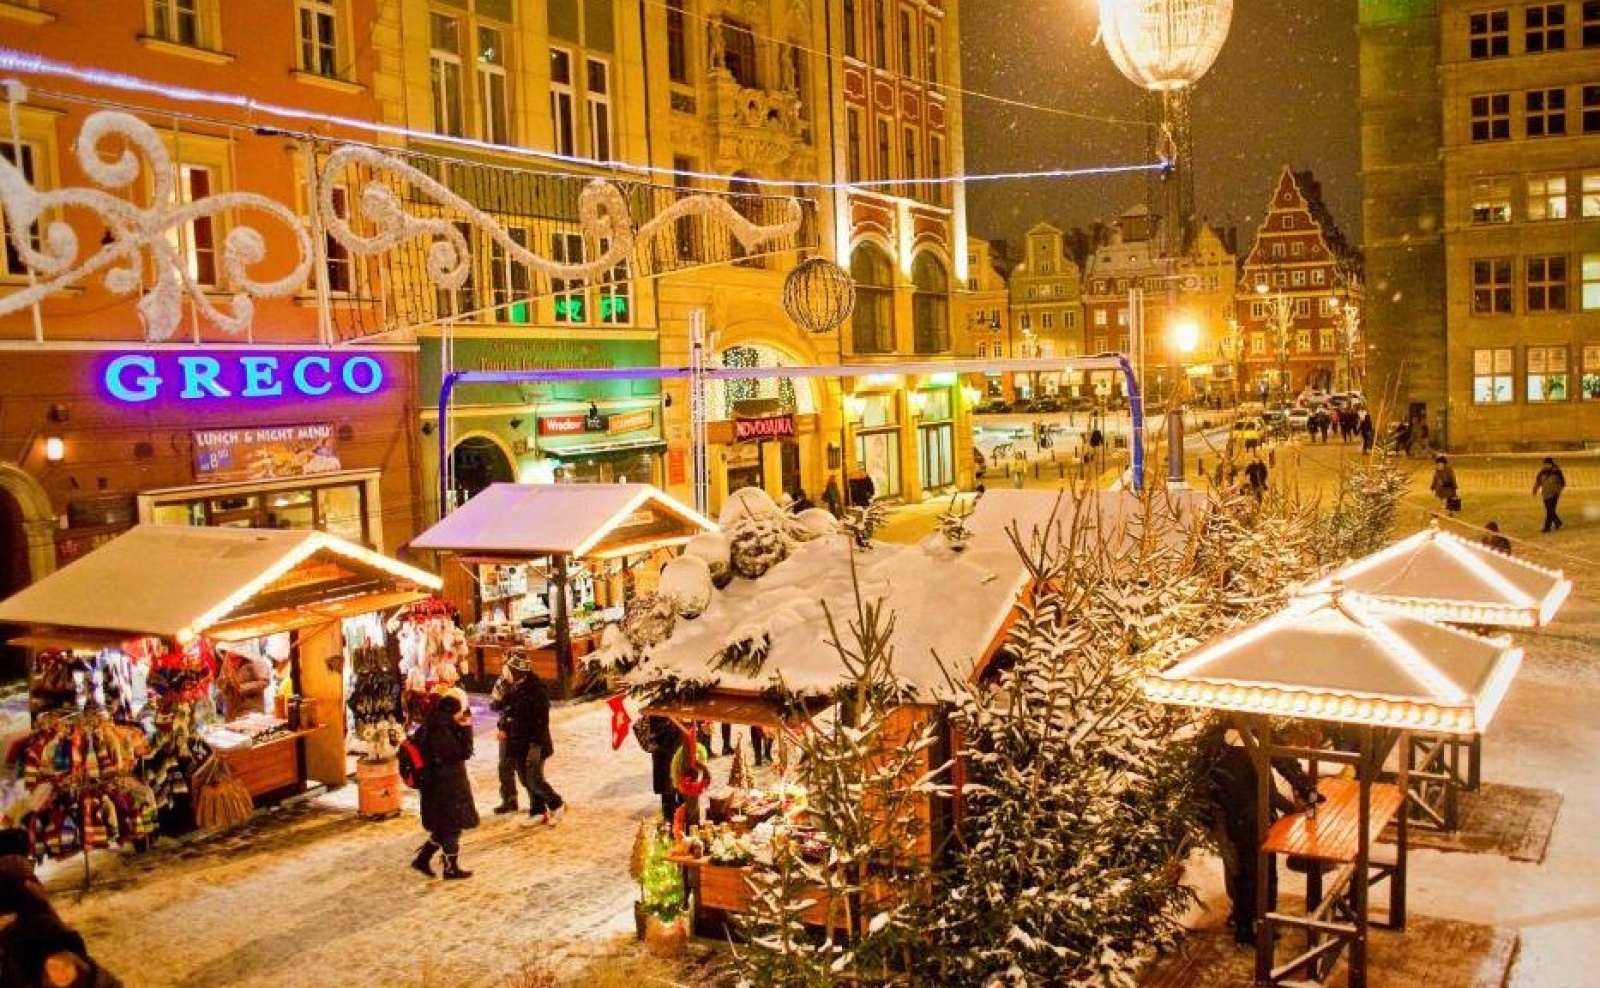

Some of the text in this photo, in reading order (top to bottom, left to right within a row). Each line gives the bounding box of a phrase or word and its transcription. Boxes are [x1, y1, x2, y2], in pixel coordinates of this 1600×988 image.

[105, 354, 383, 402] GRECO
[196, 430, 239, 447] LUNCH
[257, 428, 294, 442] NIGHT
[297, 425, 331, 440] MENU
